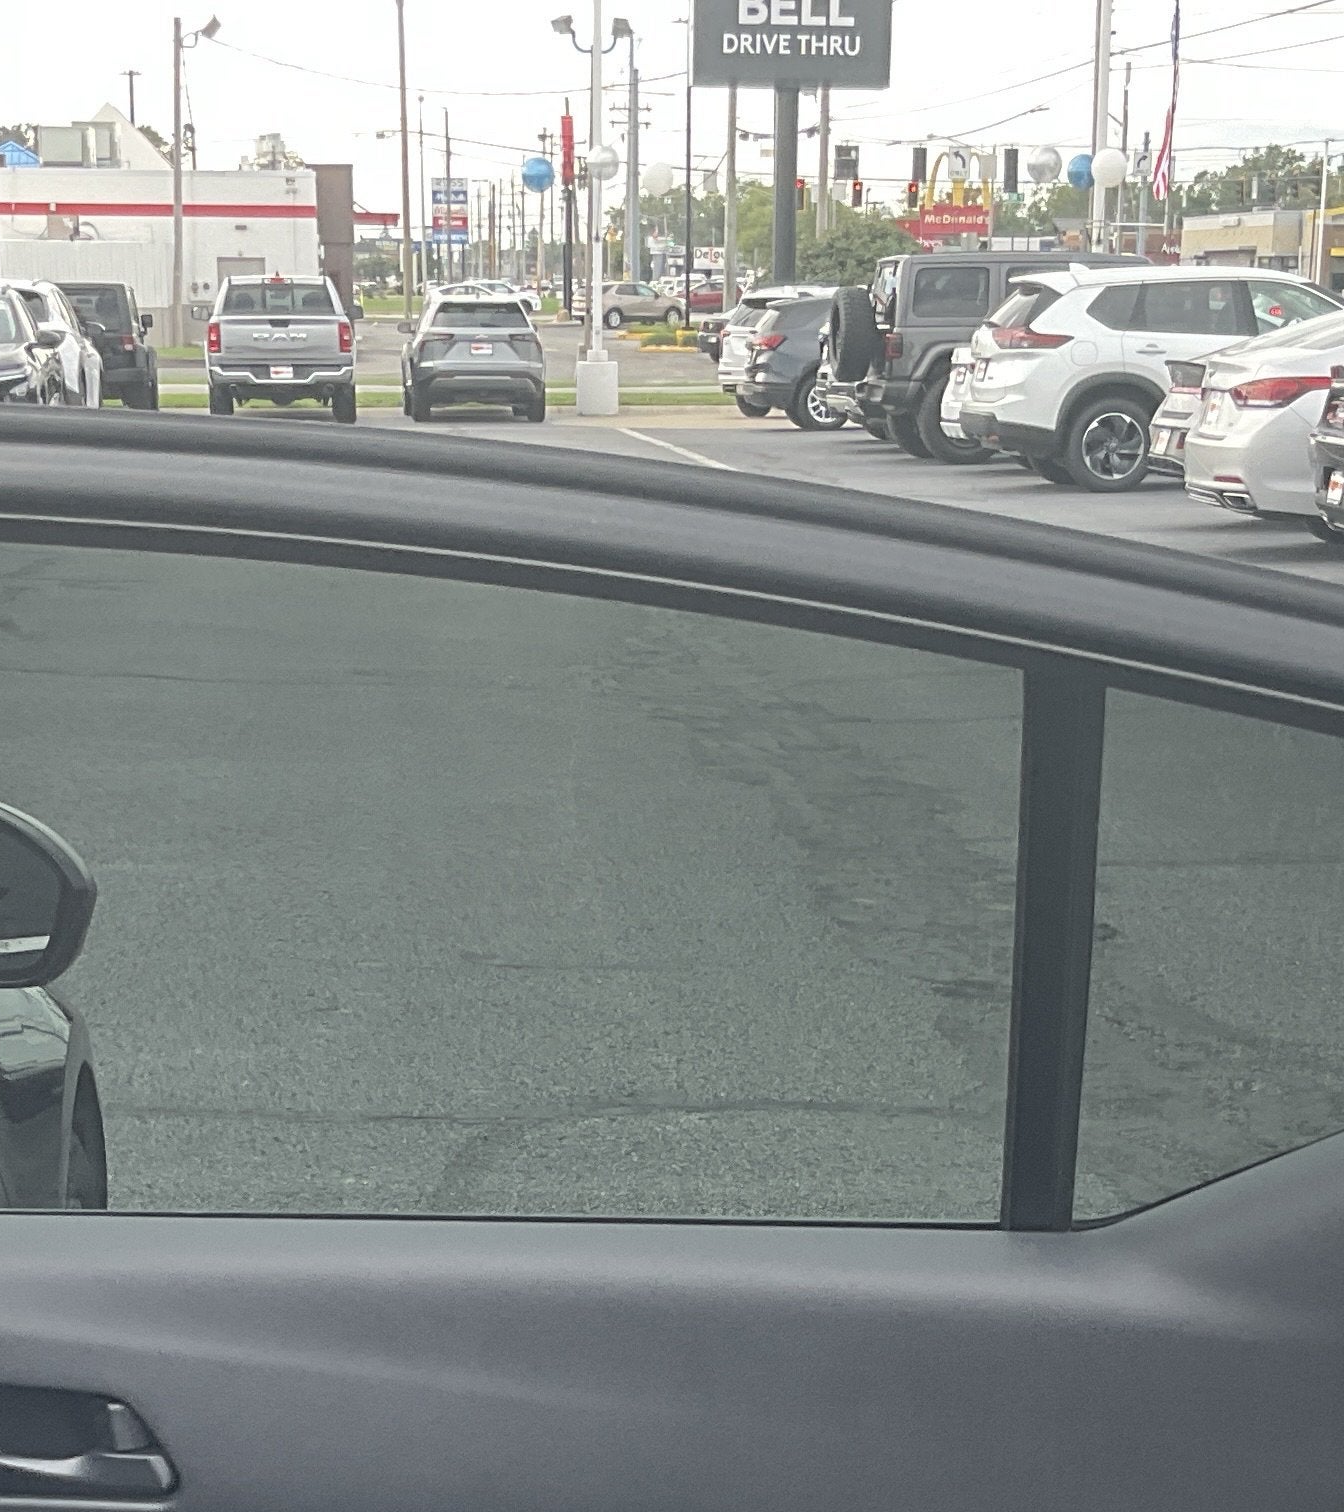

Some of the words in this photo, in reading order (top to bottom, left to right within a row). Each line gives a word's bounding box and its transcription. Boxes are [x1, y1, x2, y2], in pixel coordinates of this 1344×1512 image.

[738, 0, 855, 26] BELL
[722, 33, 791, 55] DRIVE
[797, 35, 861, 57] THRU
[252, 332, 308, 341] RAM
